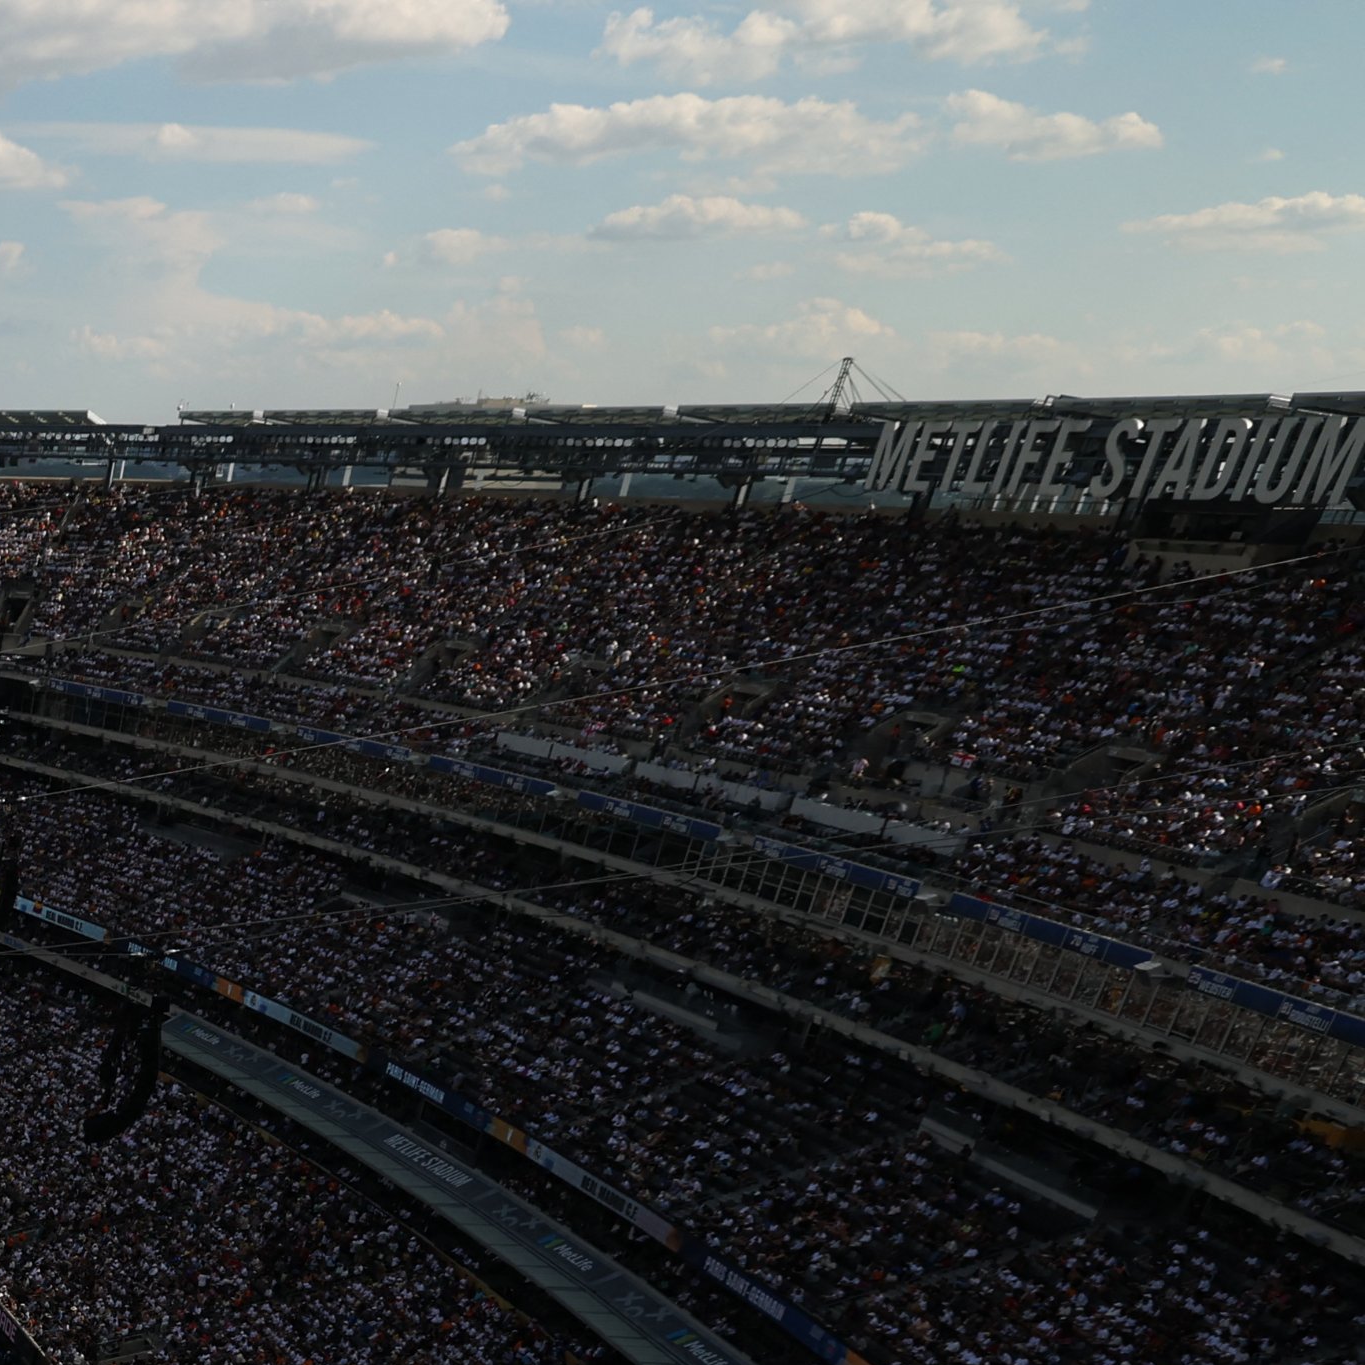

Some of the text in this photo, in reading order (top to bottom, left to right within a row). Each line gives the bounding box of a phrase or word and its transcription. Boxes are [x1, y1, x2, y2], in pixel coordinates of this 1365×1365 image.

[865, 417, 1365, 504] METLIFE STADIUM
[192, 1027, 220, 1045] MetLife
[292, 1080, 321, 1099] MetLife
[383, 1134, 473, 1188] METLIFE STADIUM
[555, 1244, 594, 1272] MetLife
[703, 1255, 787, 1321] PARIS SAINT-GERMAIN
